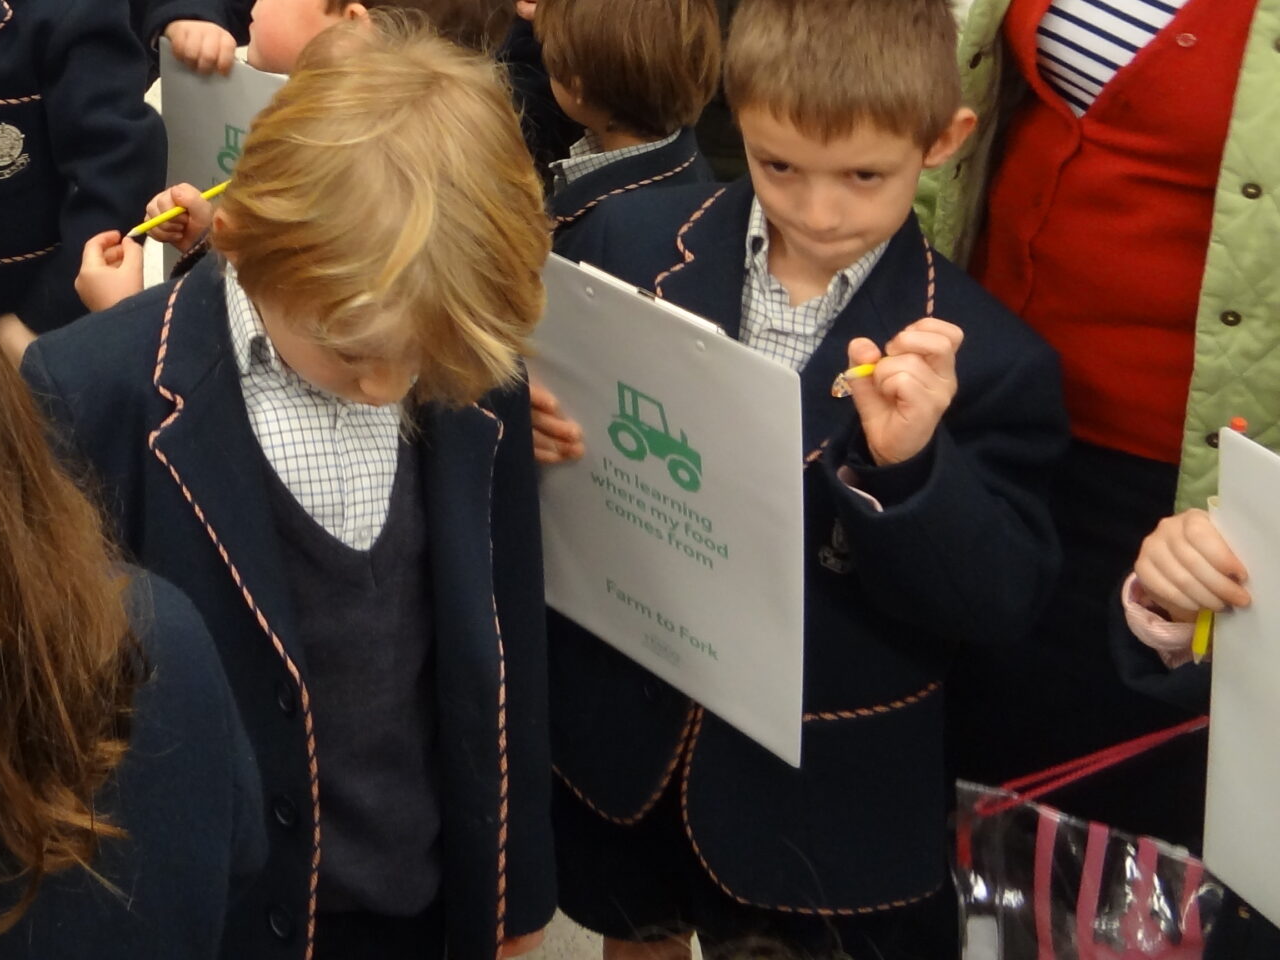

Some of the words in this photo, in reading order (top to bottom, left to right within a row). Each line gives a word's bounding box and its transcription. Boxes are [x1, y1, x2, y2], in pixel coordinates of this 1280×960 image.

[591, 471, 647, 512] where
[650, 506, 680, 531] my
[684, 522, 729, 561] food
[603, 456, 631, 485] I'm
[635, 472, 713, 534] learning
[605, 498, 664, 541] comes
[668, 531, 714, 570] from
[606, 577, 652, 619] Farm
[656, 610, 676, 633] to
[679, 624, 719, 662] Fork
